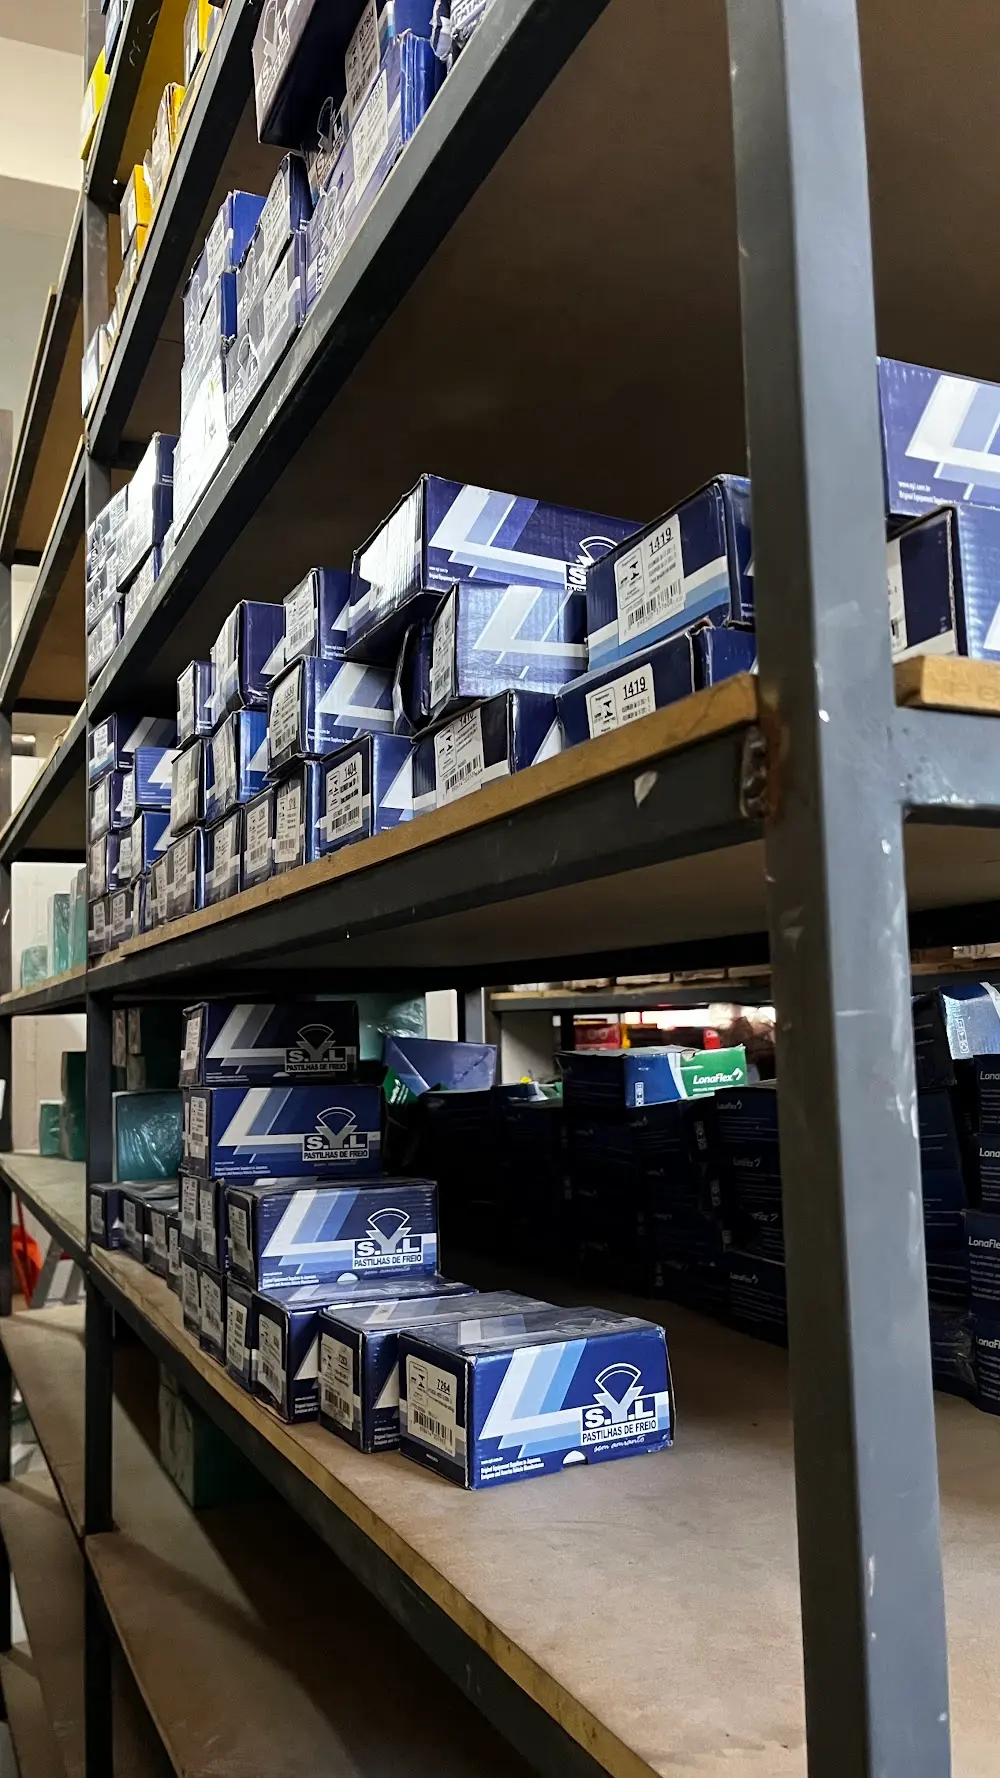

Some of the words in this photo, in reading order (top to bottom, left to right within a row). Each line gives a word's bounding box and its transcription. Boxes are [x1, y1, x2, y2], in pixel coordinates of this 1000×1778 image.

[648, 526, 673, 554] 1419
[622, 676, 646, 699] 1419
[286, 1063, 319, 1072] PASTILHAS
[328, 1062, 347, 1070] FREIO
[692, 1072, 734, 1085] LonaFlex
[306, 1125, 366, 1150] S.Y.L
[304, 1150, 339, 1160] PASTILHAS
[339, 1150, 348, 1158] DE
[349, 1149, 368, 1158] FREIO
[356, 1227, 421, 1257] S.Y.L
[354, 1256, 391, 1267] PASTILHAS
[392, 1255, 401, 1264] DE
[402, 1254, 422, 1264] FREIO
[584, 1386, 655, 1429] S.Y.L
[582, 1426, 623, 1443] PASTILHAS
[623, 1423, 634, 1435] DE
[635, 1419, 657, 1432] FREIO
